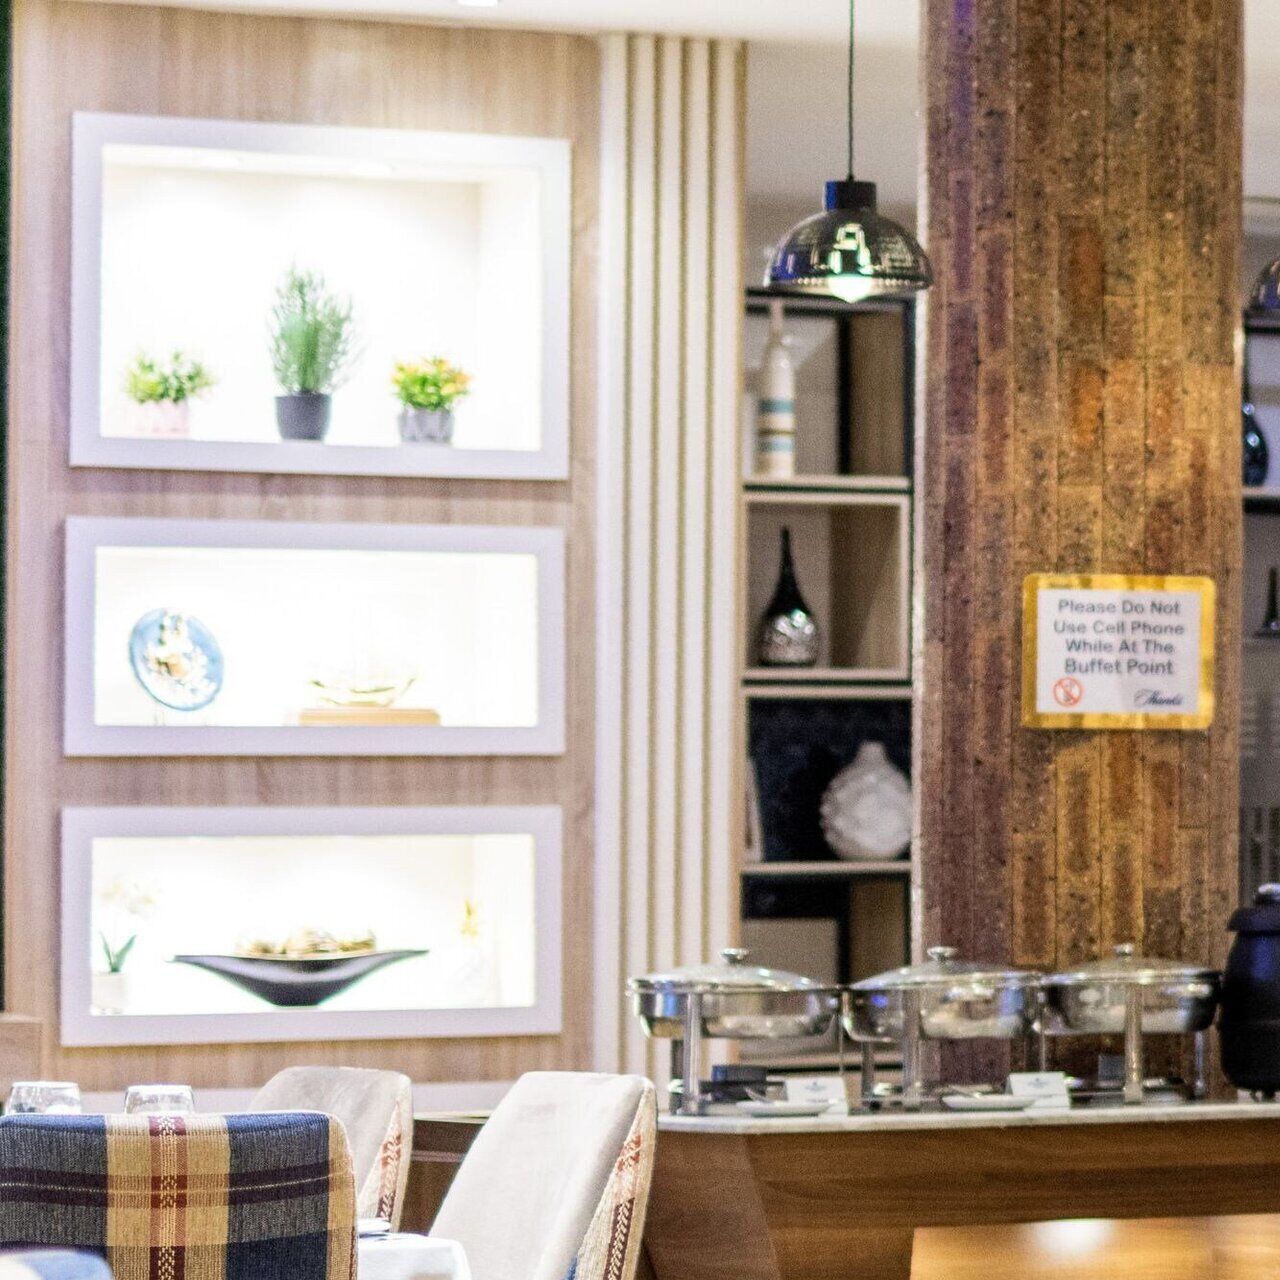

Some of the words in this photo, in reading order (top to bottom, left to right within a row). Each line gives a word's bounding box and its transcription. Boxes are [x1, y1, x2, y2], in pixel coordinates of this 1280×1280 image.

[1058, 599, 1116, 614] Please
[1121, 600, 1144, 614] Do
[1151, 600, 1180, 615] Not
[1053, 620, 1087, 634] Use
[1093, 620, 1125, 634] Cell
[1131, 621, 1185, 635] Phone
[1066, 639, 1113, 653] While
[1119, 640, 1137, 653] At
[1143, 640, 1175, 653] The
[1065, 658, 1121, 674] Buffet
[1127, 659, 1175, 675] Point
